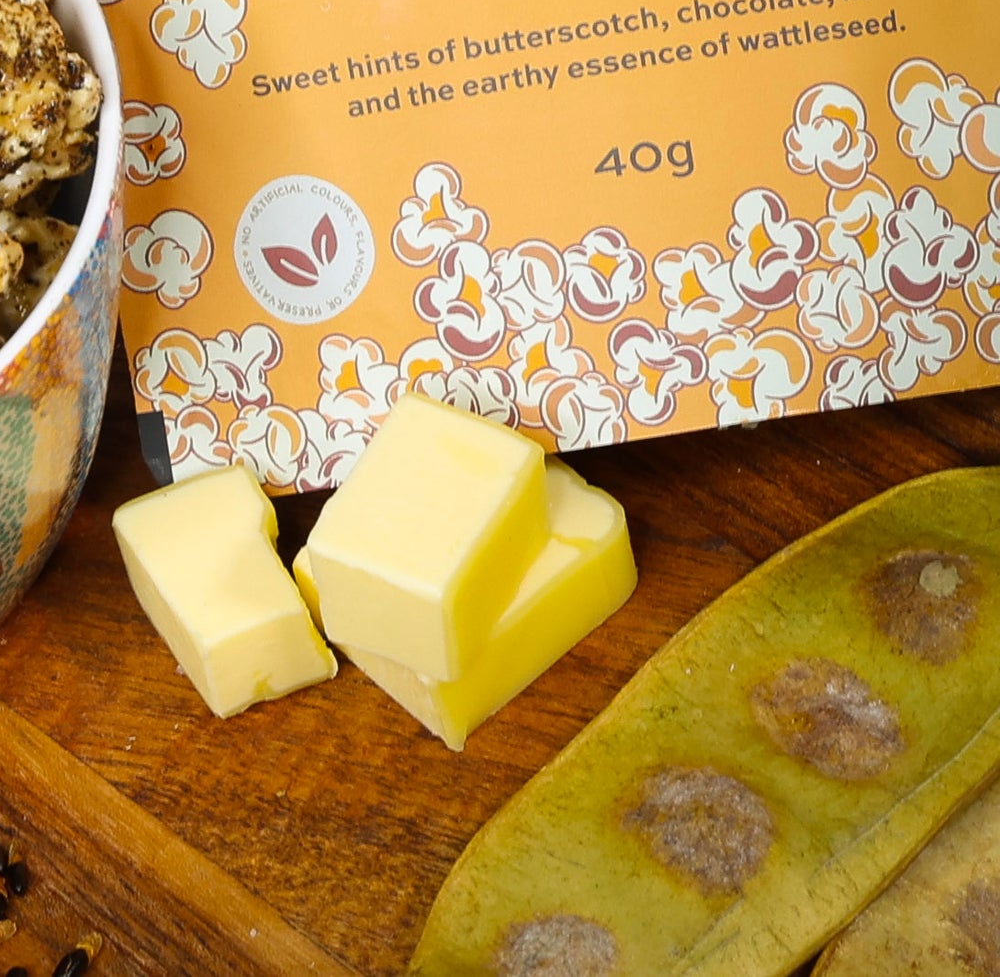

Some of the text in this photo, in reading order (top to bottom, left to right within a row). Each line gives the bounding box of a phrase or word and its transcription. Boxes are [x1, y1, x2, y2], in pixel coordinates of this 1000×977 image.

[251, 61, 341, 98] Sweet
[346, 49, 421, 81] hints
[427, 39, 457, 65] of
[463, 6, 670, 60] butterscotch,
[347, 8, 907, 118] and the earthy essence of wattleseed.
[593, 137, 696, 180] 40g
[241, 225, 252, 246] NO
[325, 295, 343, 312] OR
